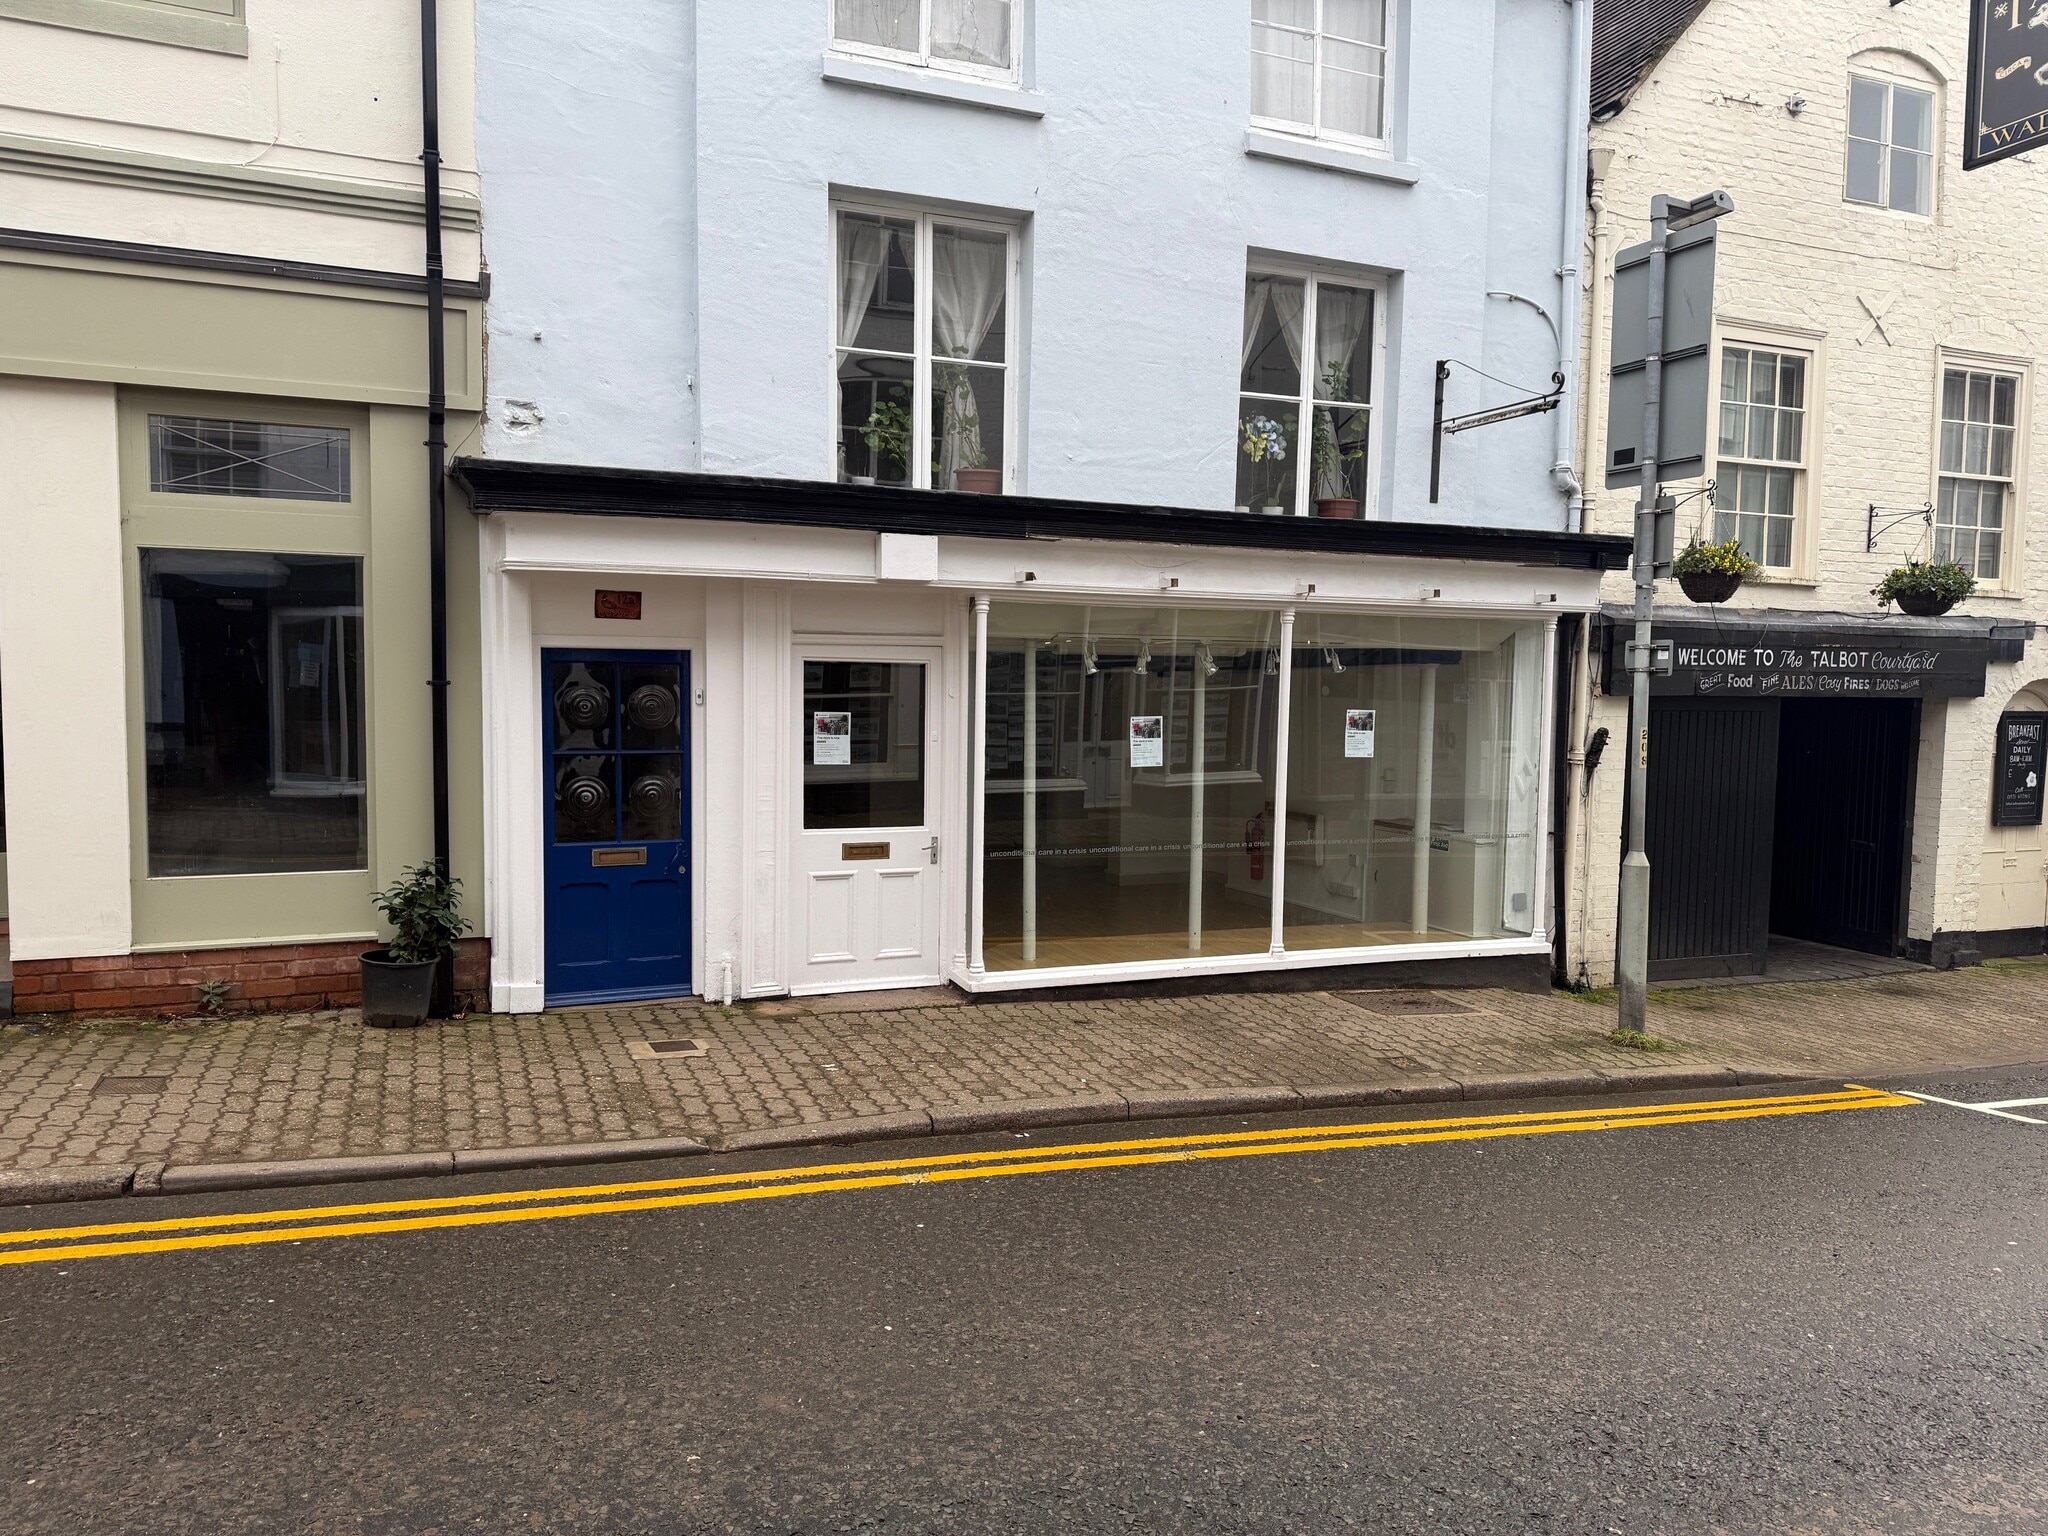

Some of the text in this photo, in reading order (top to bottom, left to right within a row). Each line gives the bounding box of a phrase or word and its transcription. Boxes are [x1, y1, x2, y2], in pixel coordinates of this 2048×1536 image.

[1678, 648, 1940, 673] WELCOME TO The TALBOT Courtyard
[1700, 673, 1723, 690] GREAT
[1727, 673, 1753, 688] Food
[1762, 674, 1779, 690] FINE
[1876, 678, 1900, 691] DOGS
[2008, 724, 2040, 741] BREAKFAST
[2013, 746, 2031, 754] DAILY
[1038, 848, 1053, 856] care
[1055, 847, 1062, 855] in
[1068, 847, 1087, 855] crisis
[1089, 845, 1133, 853] unconditional
